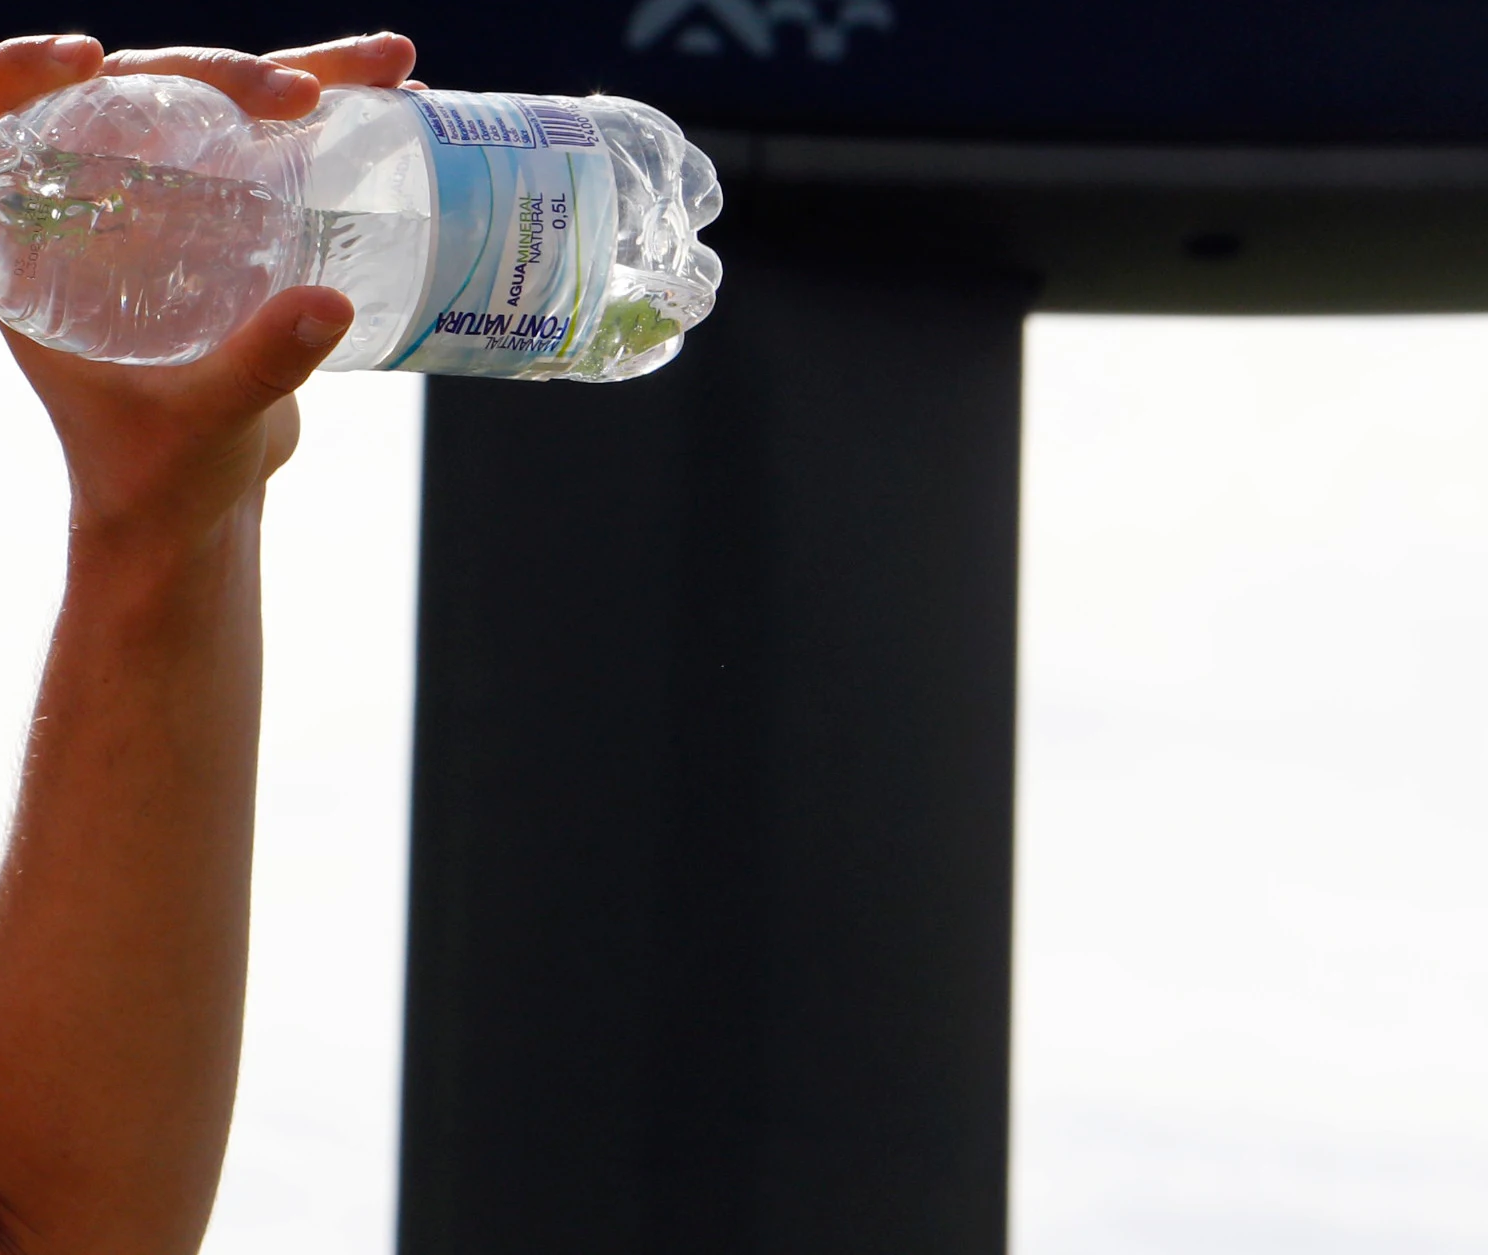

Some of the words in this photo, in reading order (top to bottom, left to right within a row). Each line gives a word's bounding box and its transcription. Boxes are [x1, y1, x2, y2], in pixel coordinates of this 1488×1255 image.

[466, 119, 481, 141] Sulfatos
[476, 119, 491, 141] Cloruros
[488, 124, 502, 142] Calcio
[576, 116, 600, 144] 2400
[550, 193, 569, 230] 0,5L
[528, 192, 544, 264] NATURAL
[434, 310, 514, 336] NATURA
[510, 313, 570, 340] FONT
[485, 336, 560, 352] MANANTIAL
